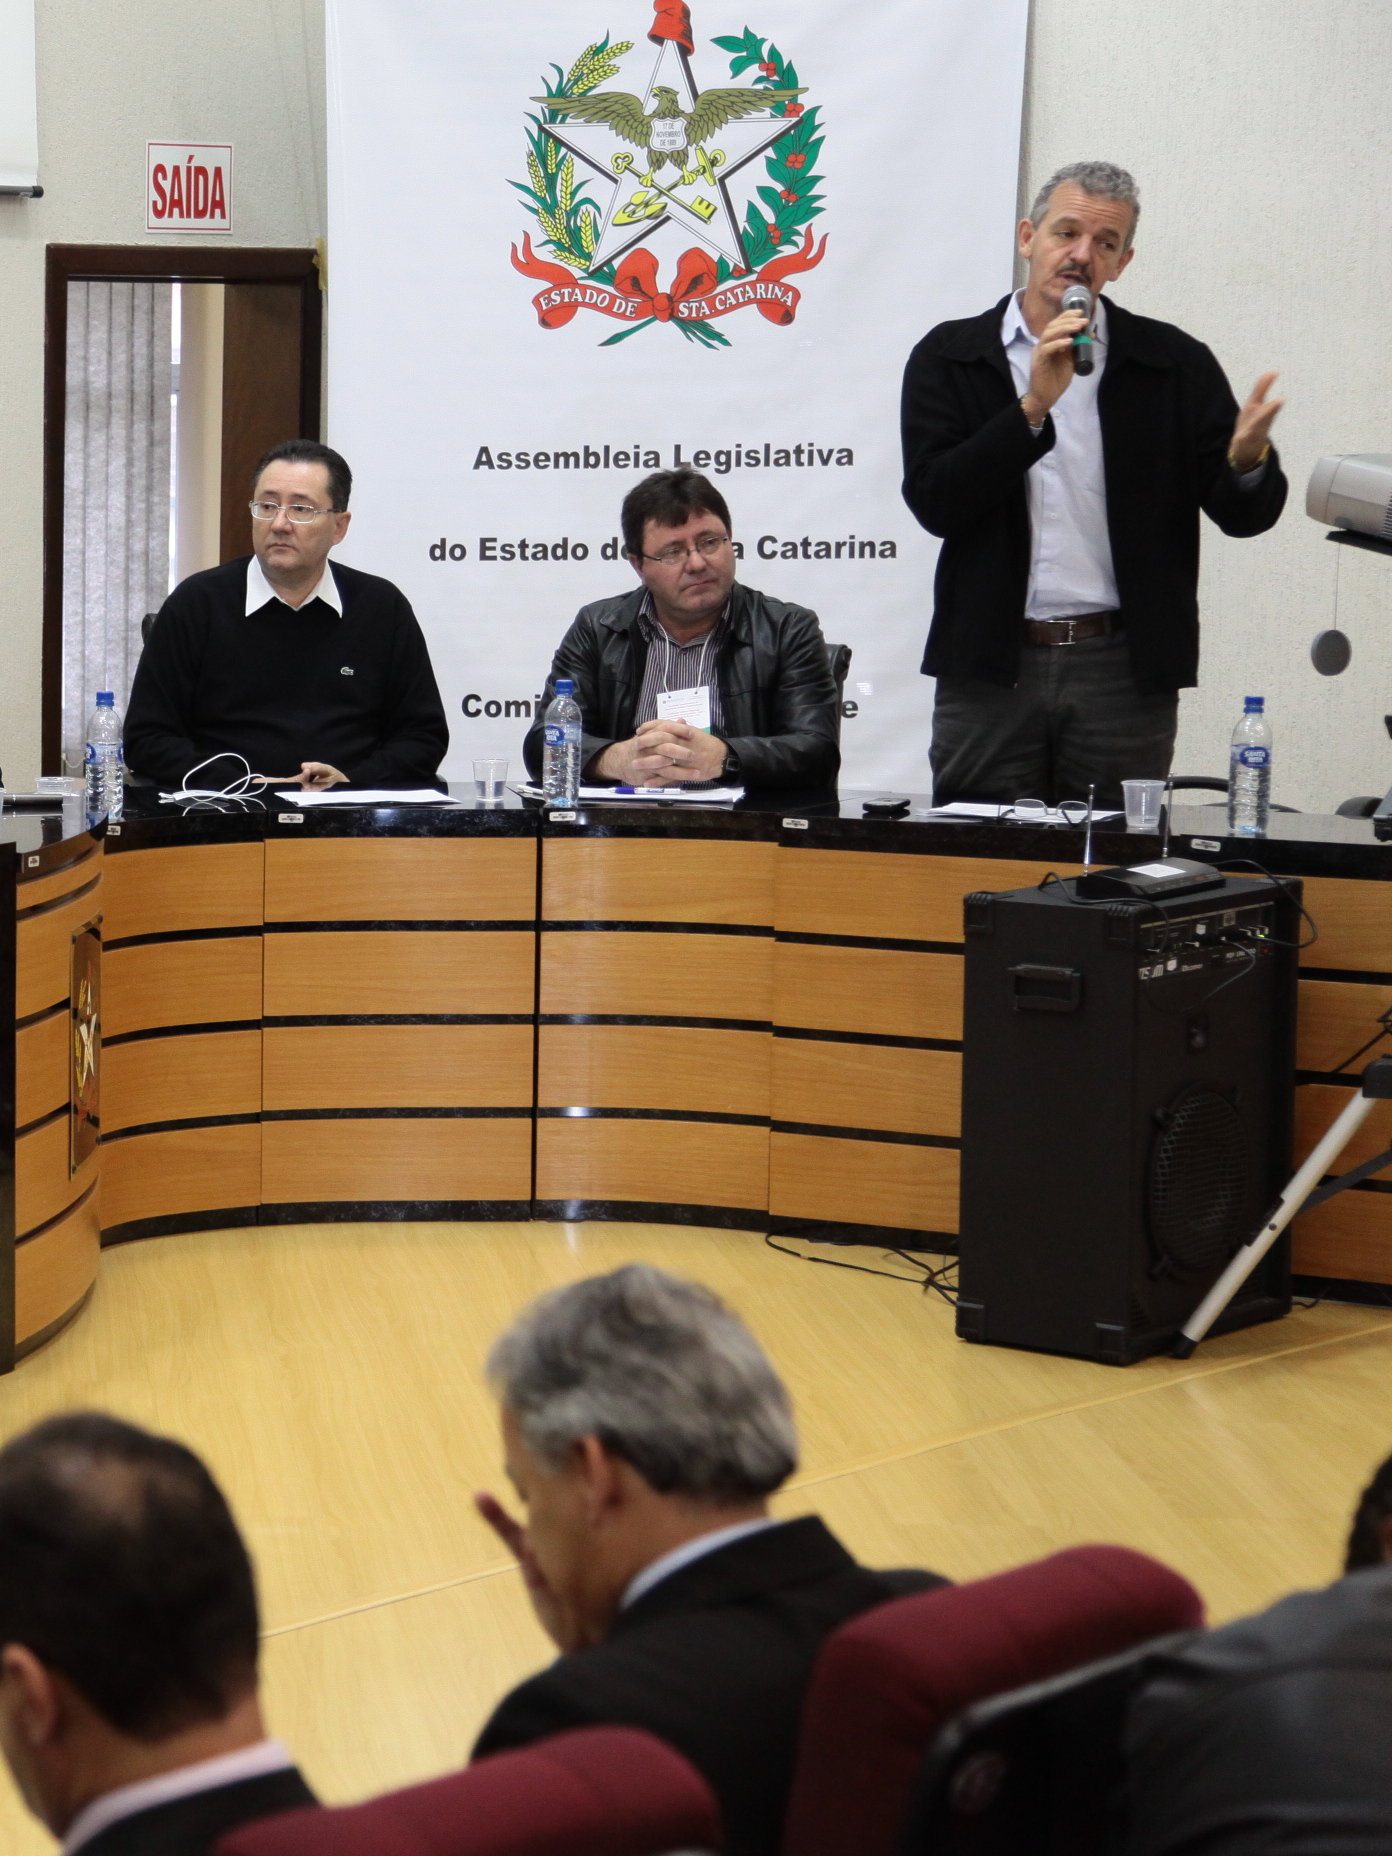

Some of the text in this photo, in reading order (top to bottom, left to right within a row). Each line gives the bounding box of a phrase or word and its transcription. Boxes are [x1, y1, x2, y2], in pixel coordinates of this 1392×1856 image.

[152, 154, 227, 220] SAÍDA
[539, 287, 610, 311] ESTADO
[611, 298, 638, 318] DE
[715, 282, 794, 310] CATARINA
[473, 443, 854, 475] Assembleia Legislativa
[429, 537, 467, 562] do
[479, 536, 589, 562] Estado
[756, 534, 897, 560] Catarina
[461, 693, 543, 718] Comi
